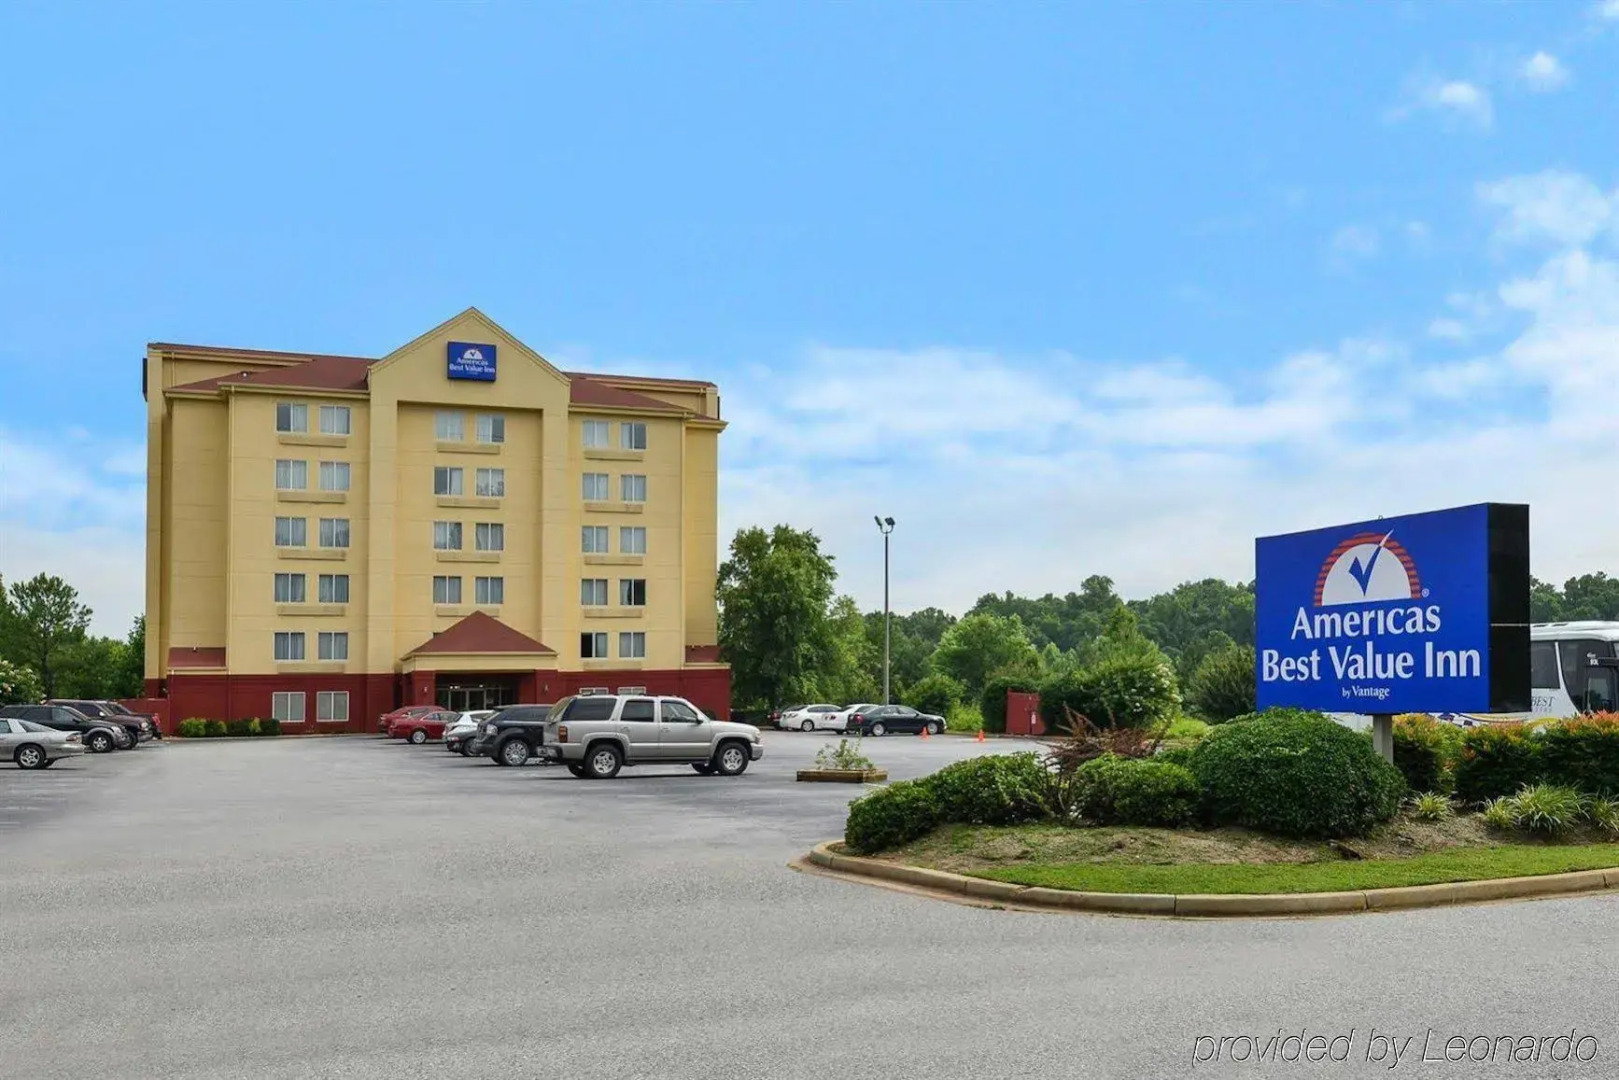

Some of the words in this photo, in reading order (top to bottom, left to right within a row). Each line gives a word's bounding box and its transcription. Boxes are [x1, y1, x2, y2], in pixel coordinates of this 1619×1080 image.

[449, 363, 463, 371] Best
[464, 364, 483, 372] Value
[484, 365, 496, 373] Inn
[1291, 605, 1441, 640] Americas
[1262, 649, 1321, 682] Best
[1329, 641, 1414, 680] Value
[1425, 642, 1481, 678] Inn
[1342, 688, 1351, 699] by
[1352, 685, 1390, 700] Vantage
